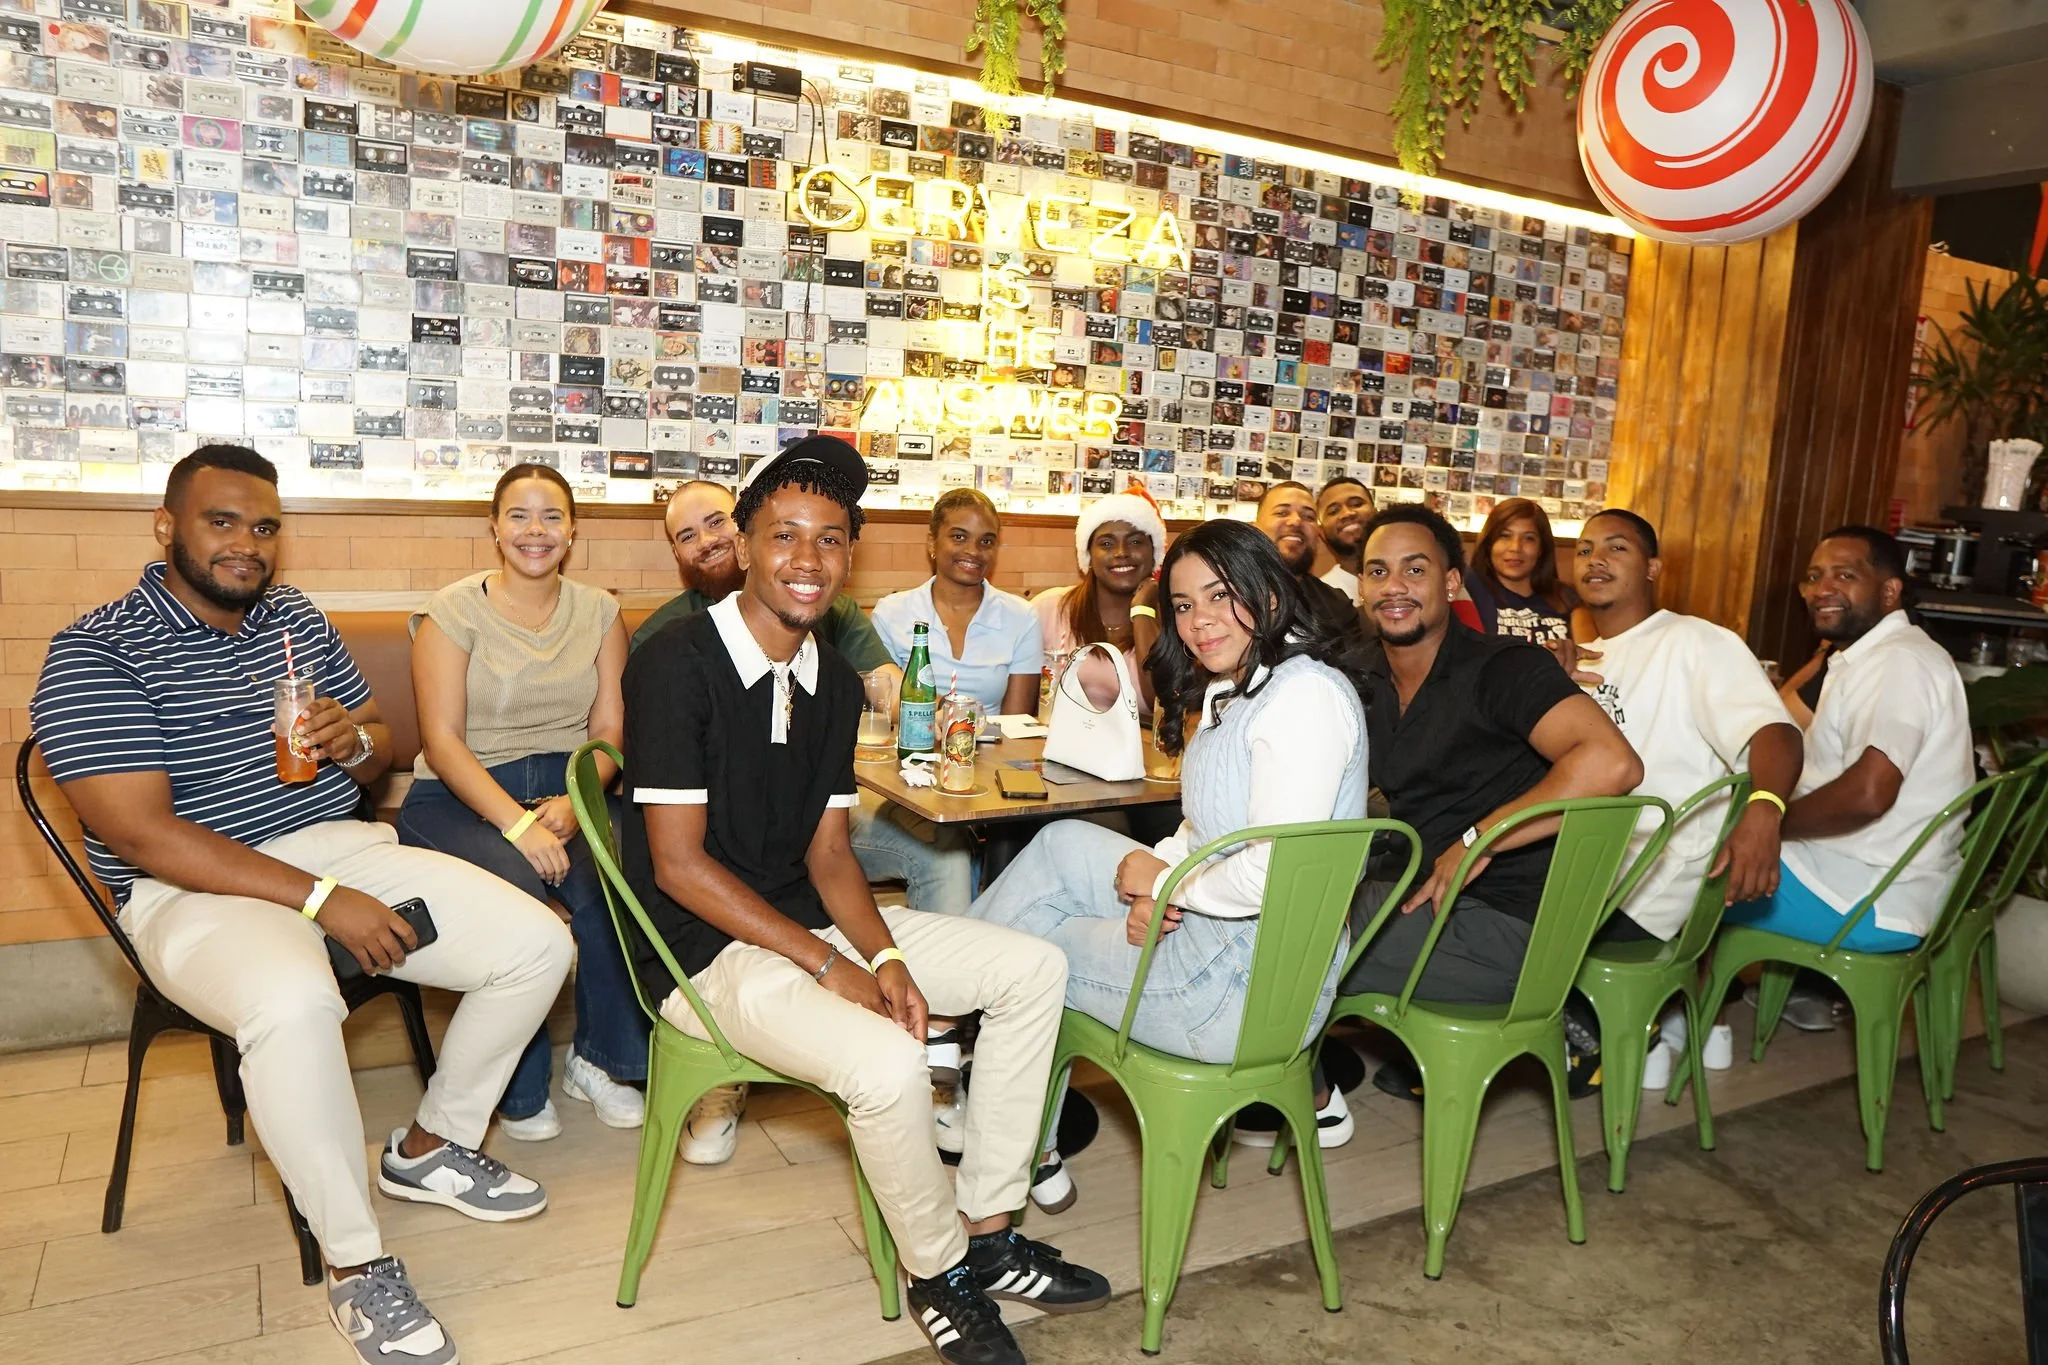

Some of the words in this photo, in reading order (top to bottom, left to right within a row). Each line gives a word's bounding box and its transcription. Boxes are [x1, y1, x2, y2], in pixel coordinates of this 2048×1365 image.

[799, 162, 1190, 271] CERVEZA
[980, 262, 1032, 310] IS
[937, 318, 1061, 371] THE
[863, 380, 1124, 436] ANSWER
